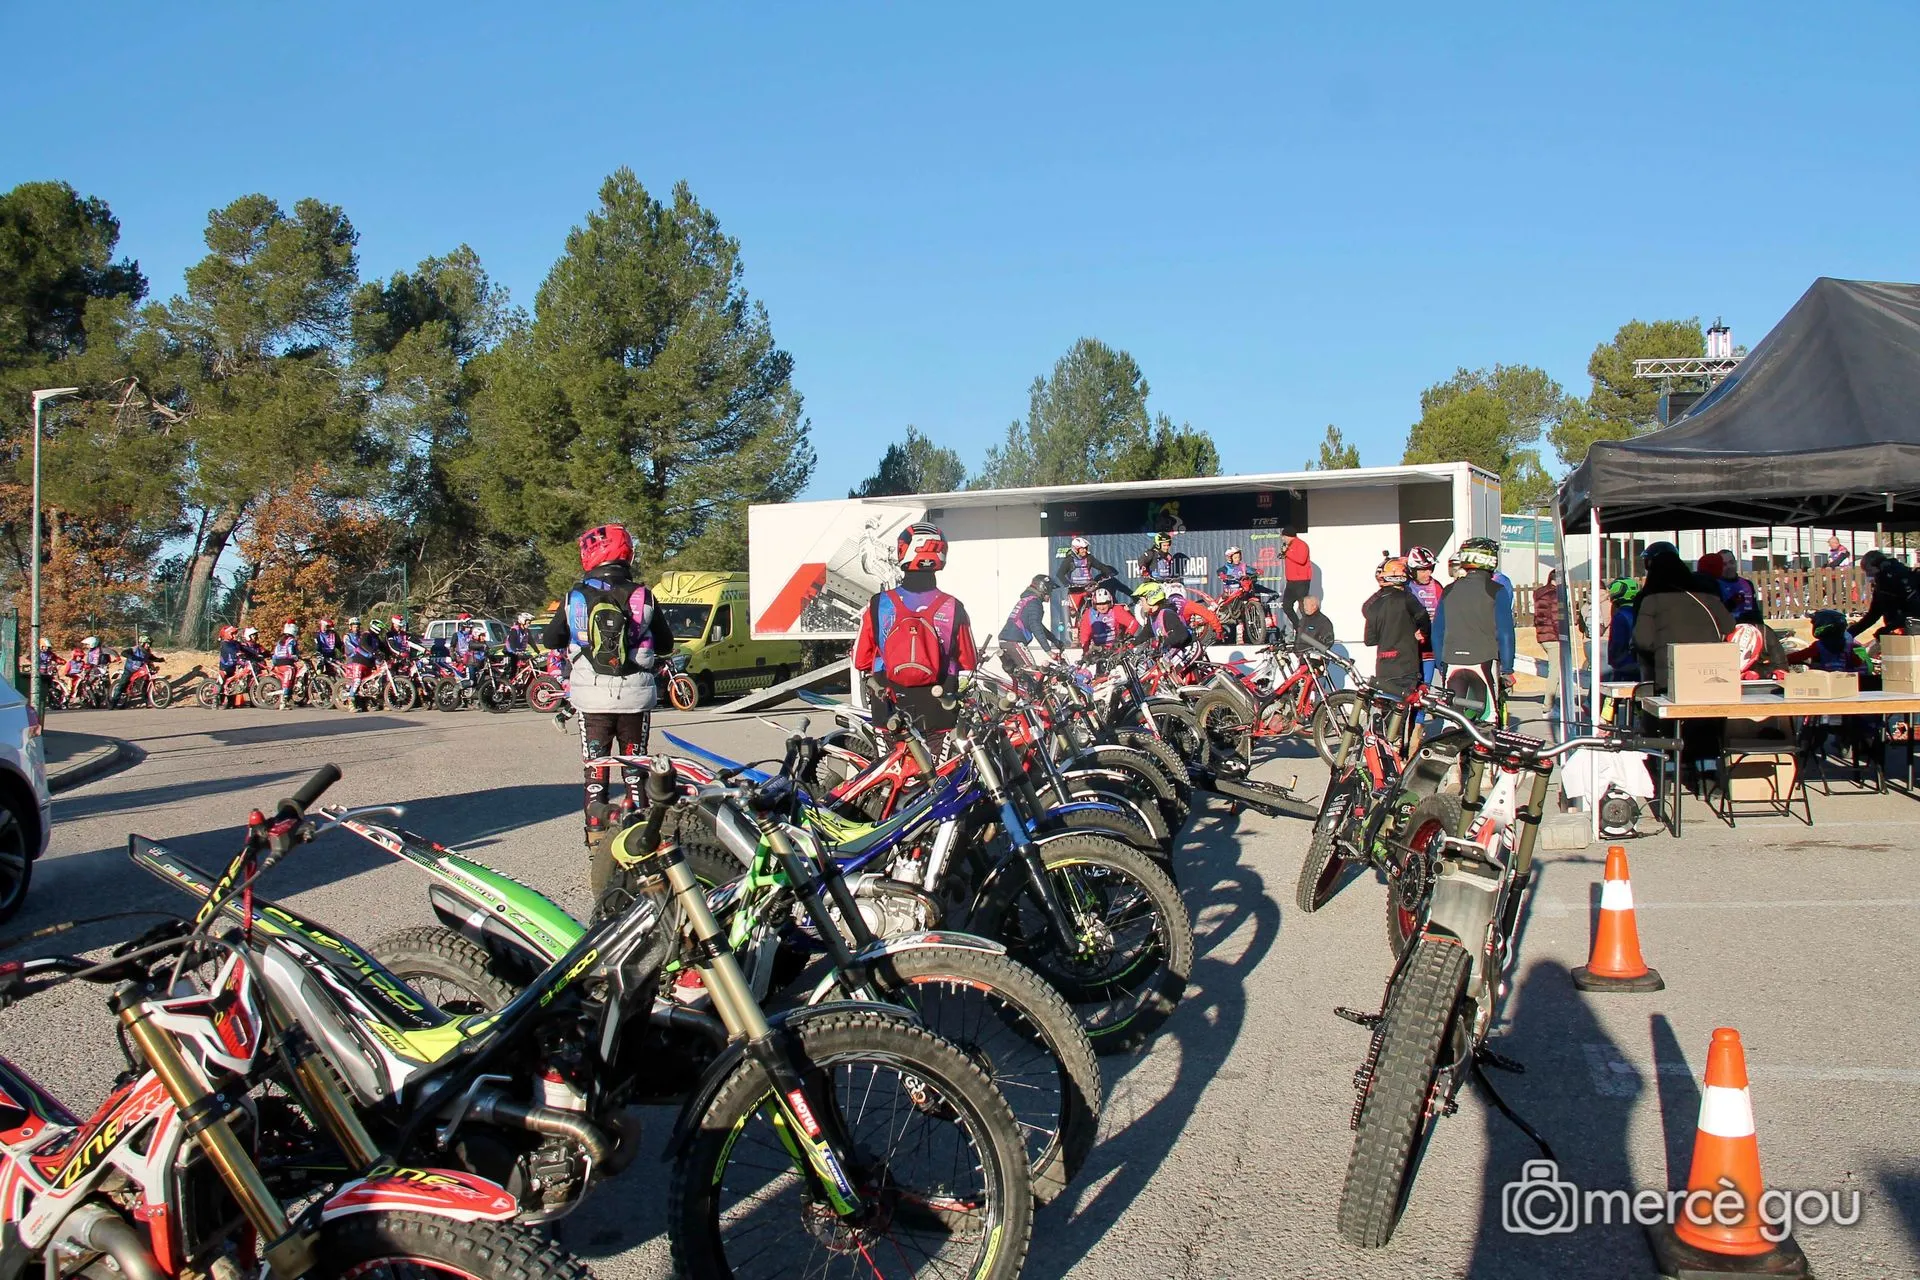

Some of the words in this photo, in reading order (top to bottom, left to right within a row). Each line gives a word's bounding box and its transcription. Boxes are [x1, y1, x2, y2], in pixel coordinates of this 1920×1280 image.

[1501, 525, 1523, 534] RANT
[1496, 733, 1540, 747] RENTHAL
[540, 948, 598, 1007] SHERCO
[376, 1025, 408, 1051] 300
[789, 1091, 821, 1135] MOTUL
